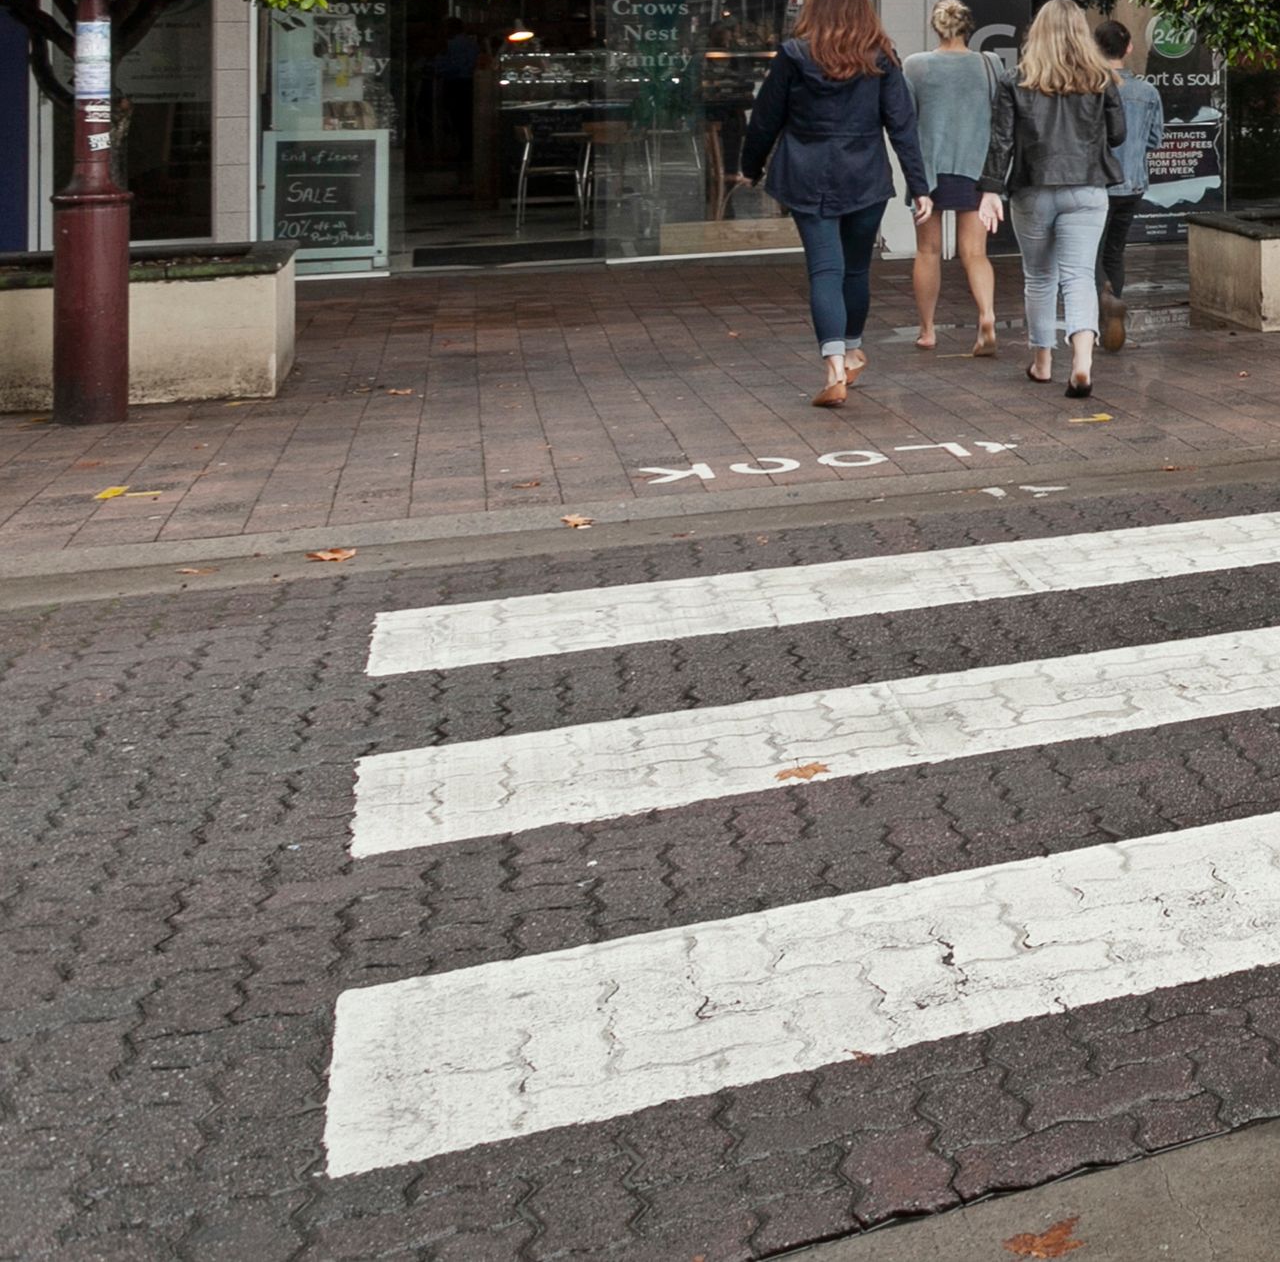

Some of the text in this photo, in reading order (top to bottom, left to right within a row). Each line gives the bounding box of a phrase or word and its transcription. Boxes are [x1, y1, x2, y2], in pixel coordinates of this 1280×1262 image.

[623, 24, 679, 43] Nest
[609, 52, 693, 70] Pantry
[1172, 72, 1184, 86] &
[1187, 70, 1221, 86] soul
[1162, 131, 1207, 140] ONTRACTS
[1159, 140, 1213, 149] ART UP FEES
[1146, 151, 1203, 159] EMBERSHIPS
[1149, 159, 1170, 167] ROM
[1150, 166, 1195, 175] PER WEEK
[287, 181, 338, 204] SALE
[278, 219, 311, 238] 20%
